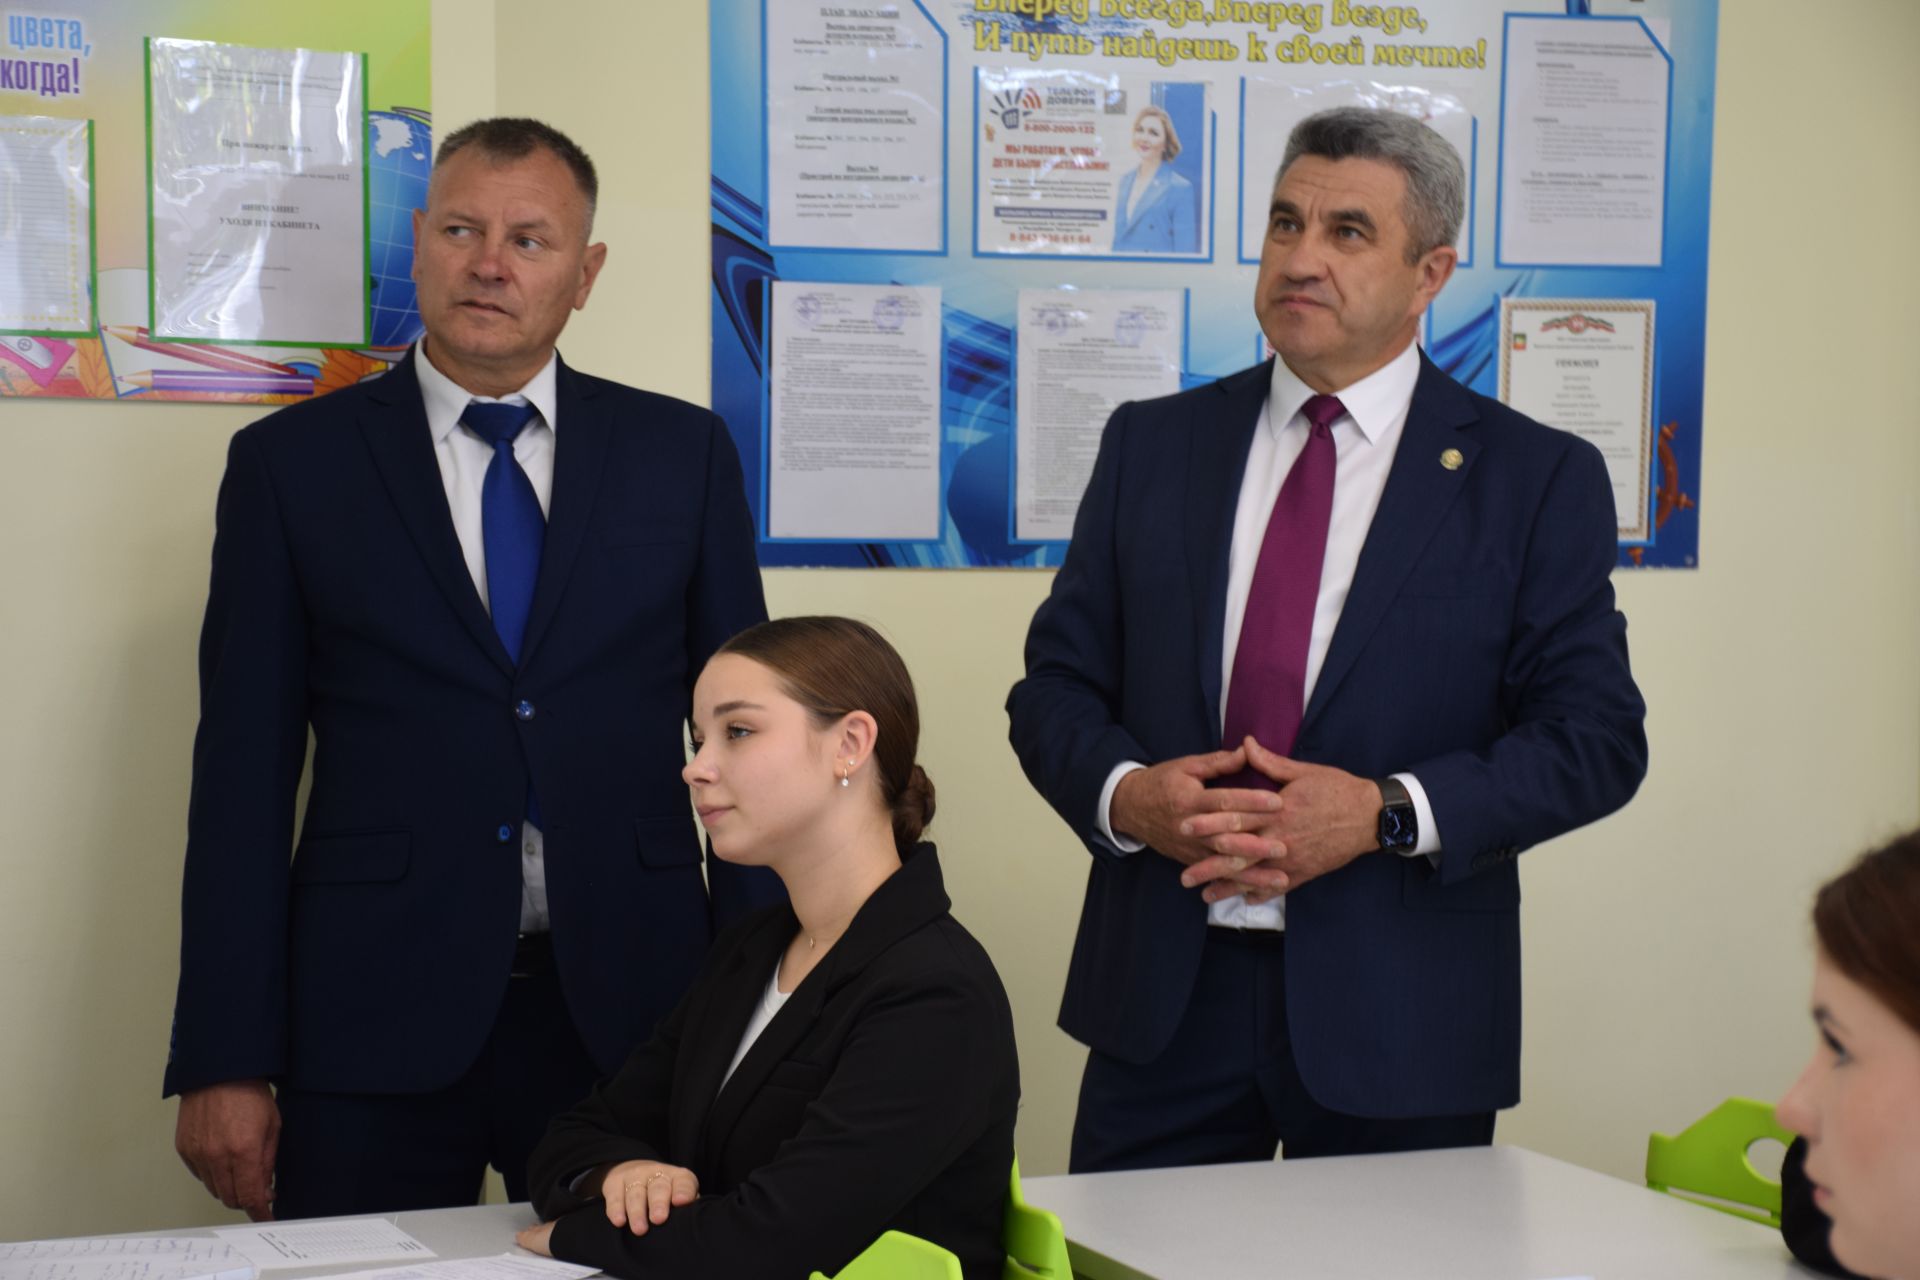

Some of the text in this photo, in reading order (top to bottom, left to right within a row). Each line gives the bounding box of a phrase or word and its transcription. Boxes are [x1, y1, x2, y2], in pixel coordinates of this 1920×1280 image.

[9, 15, 91, 58] цвета,
[974, 21, 1487, 70] И путь найдешь к своей мечте!
[0, 57, 80, 97] когда!
[1046, 96, 1096, 106] ДОВЕРИЯ
